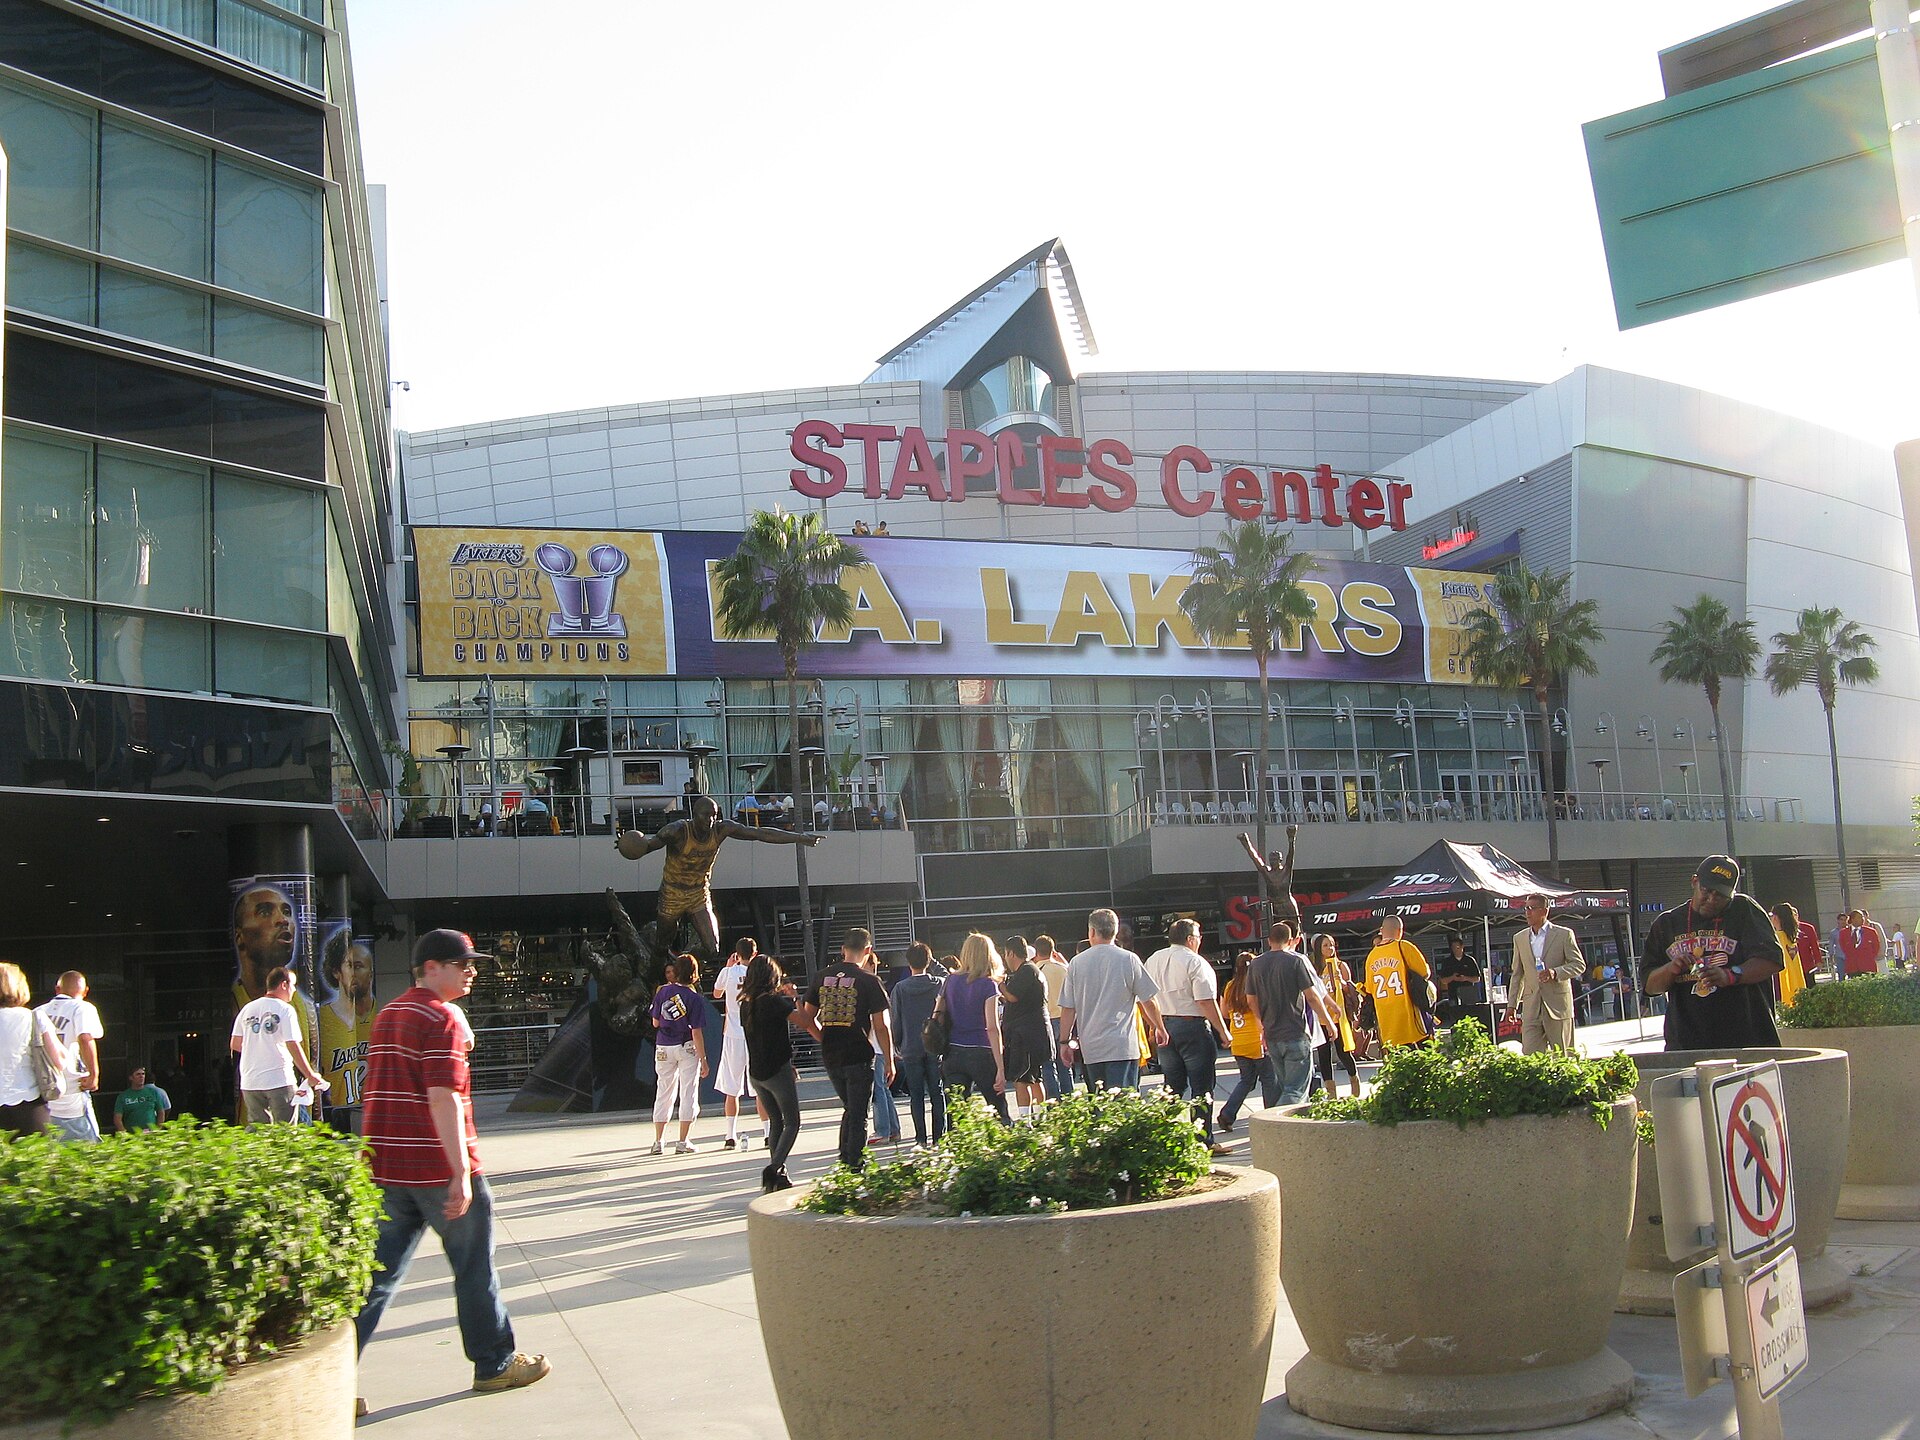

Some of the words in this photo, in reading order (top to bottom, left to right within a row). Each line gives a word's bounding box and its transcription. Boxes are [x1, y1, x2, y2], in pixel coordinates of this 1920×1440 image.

[789, 419, 1138, 513] STAPLES
[1160, 444, 1413, 532] Center
[450, 543, 530, 567] LAKERS
[449, 567, 541, 599] BACK
[705, 558, 943, 644] LA.
[452, 606, 543, 639] BACK
[453, 642, 630, 663] CHAMPIONS
[1388, 873, 1440, 887] 710
[1396, 904, 1421, 916] 710
[1420, 901, 1457, 914] ESPN
[1494, 898, 1509, 909] 710
[1586, 898, 1600, 907] 710
[1313, 912, 1338, 925] 710
[1337, 909, 1373, 922] ESPN
[1371, 957, 1399, 973] BRYANT
[1373, 971, 1404, 999] 24
[1760, 1320, 1803, 1369] CROSSWALK
